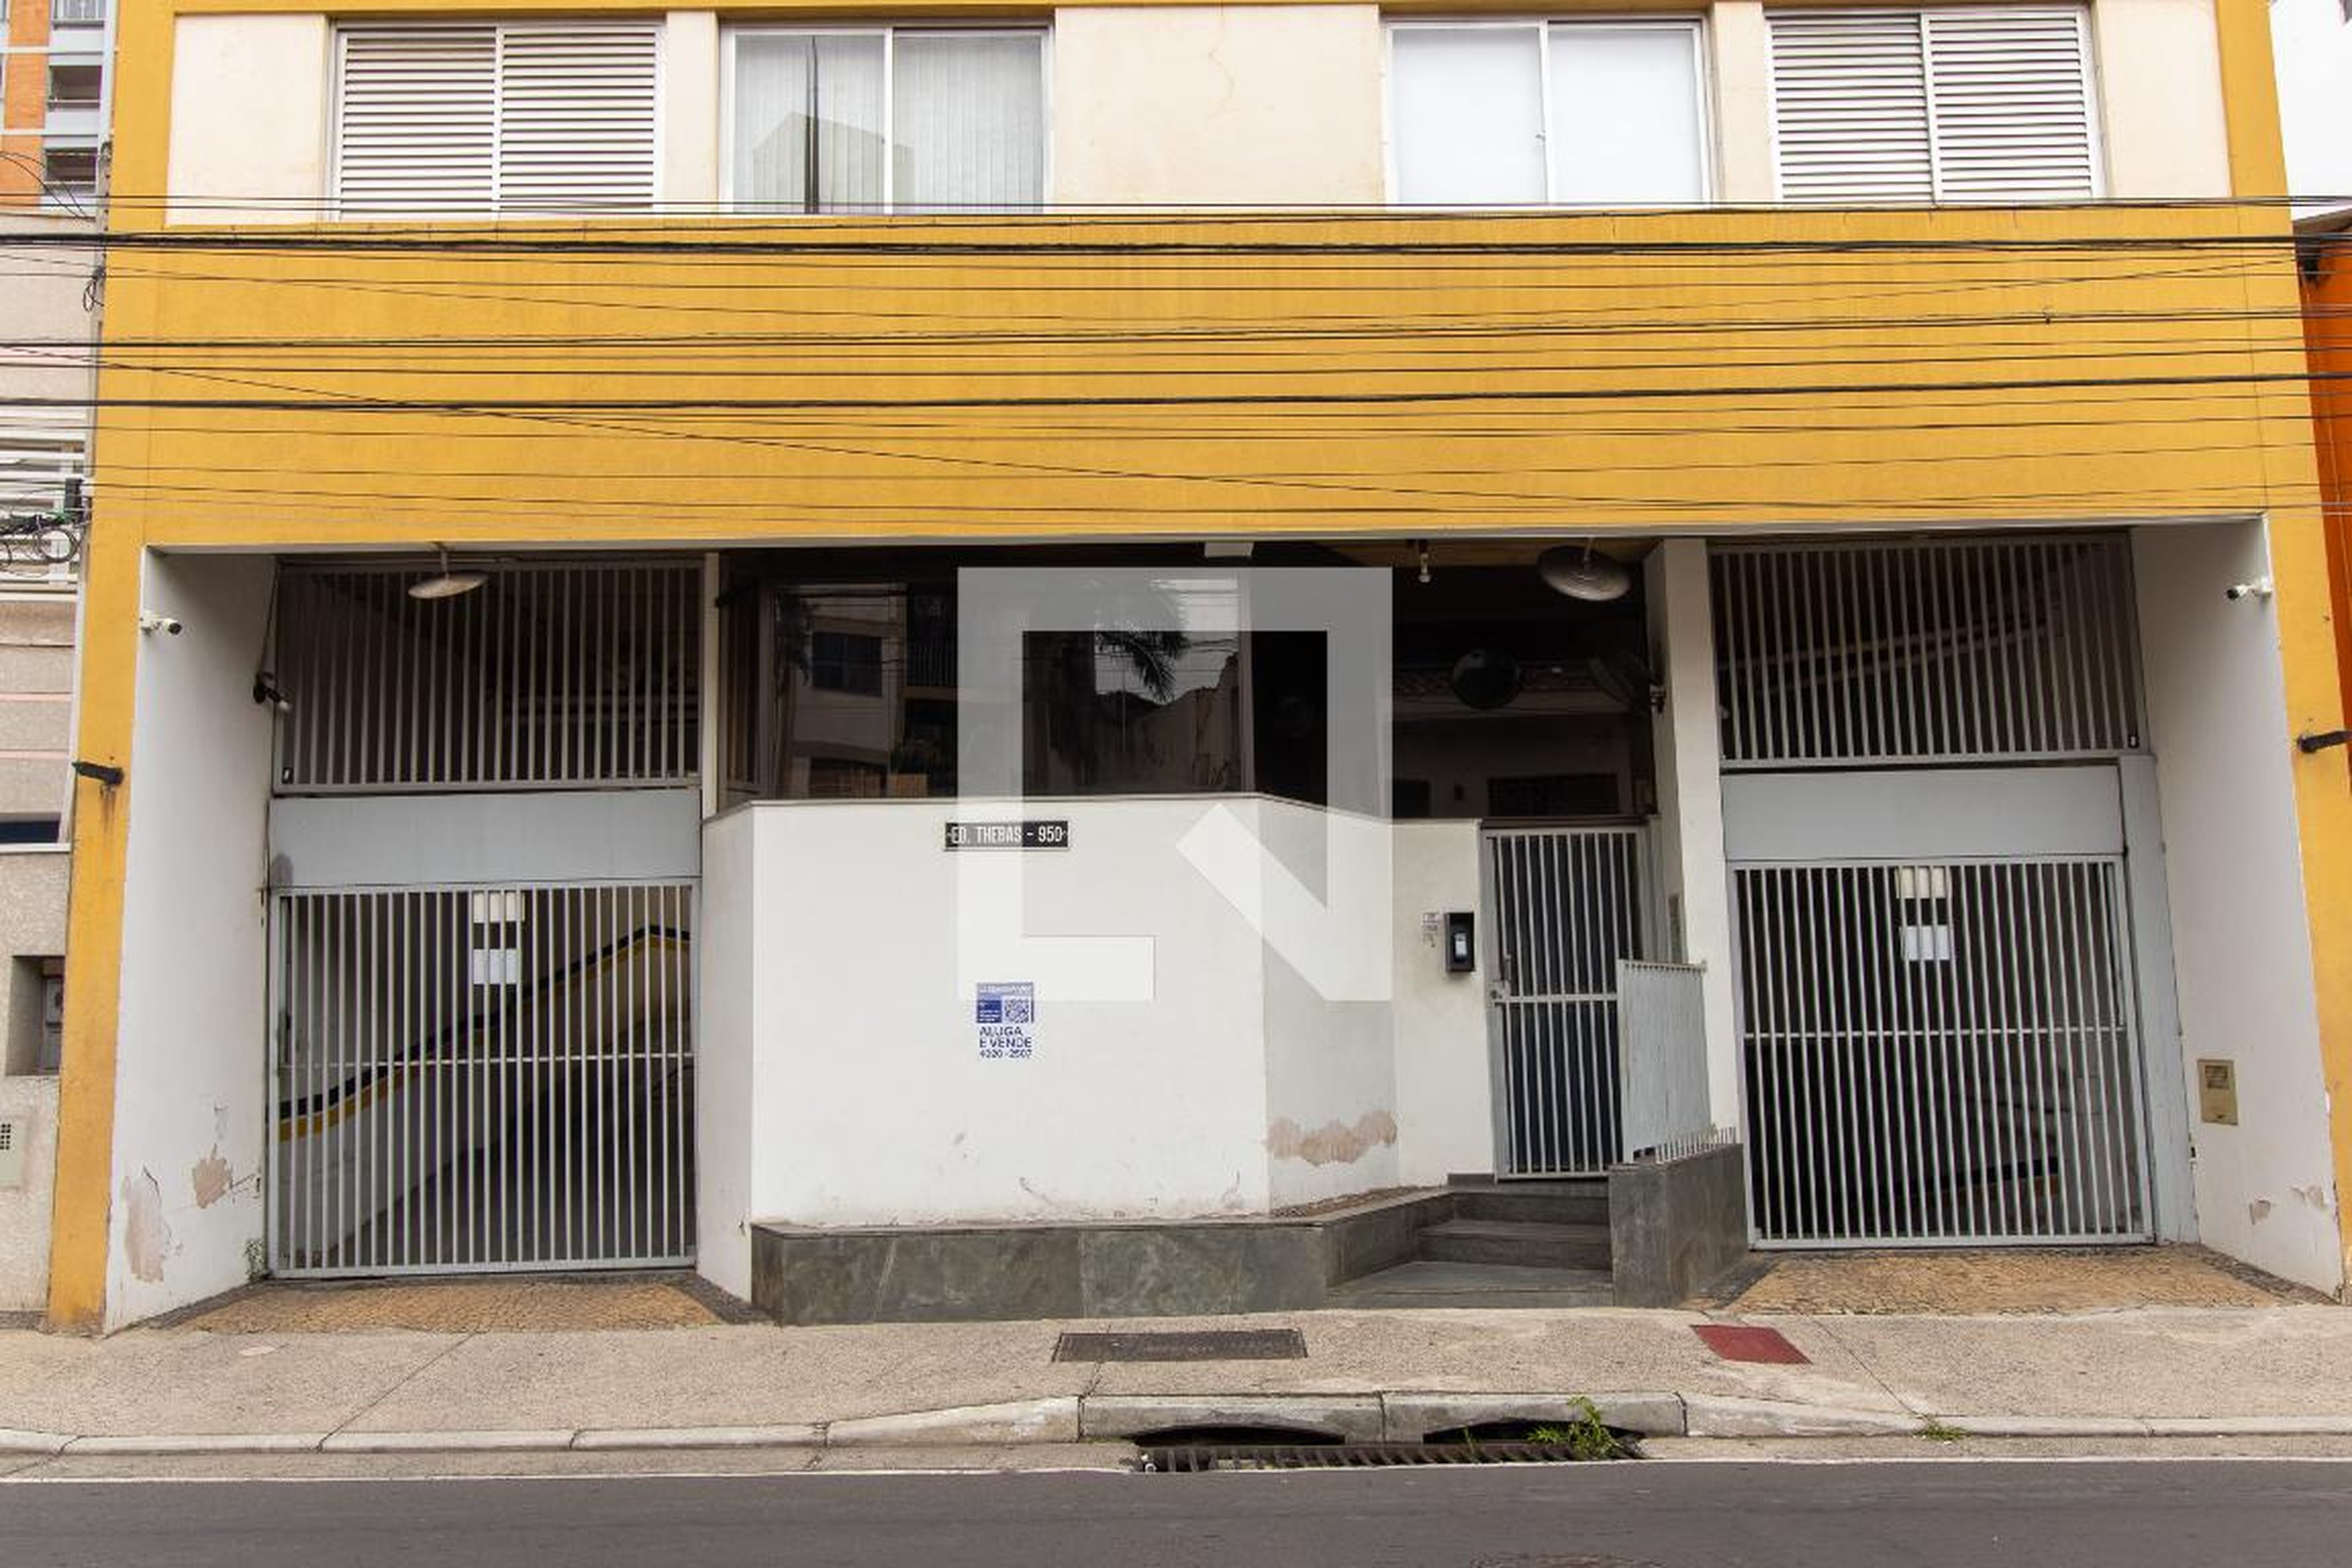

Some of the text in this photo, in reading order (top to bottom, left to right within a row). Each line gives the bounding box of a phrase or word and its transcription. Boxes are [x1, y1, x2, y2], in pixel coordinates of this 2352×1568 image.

[976, 826, 1022, 843] THEBAS
[1038, 825, 1061, 843] 950
[979, 1026, 1023, 1036] ALUGA
[979, 1036, 1032, 1048] E VENDE
